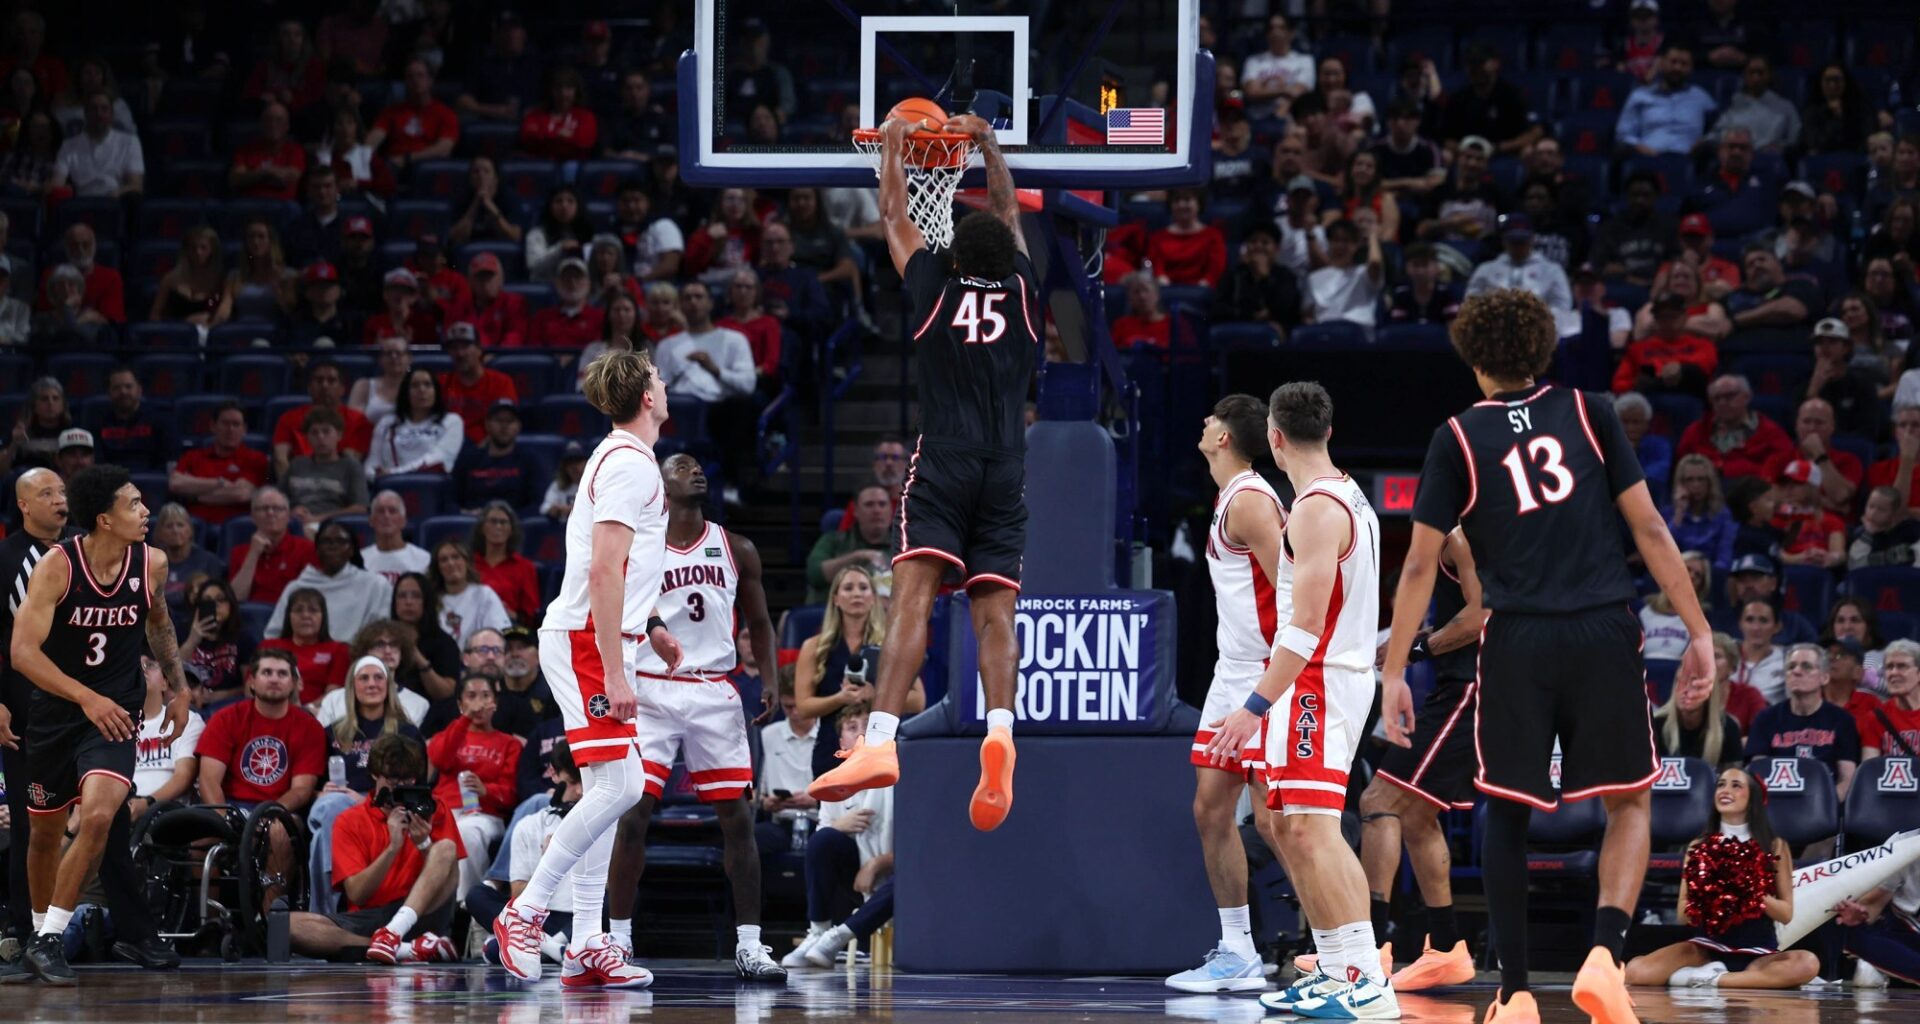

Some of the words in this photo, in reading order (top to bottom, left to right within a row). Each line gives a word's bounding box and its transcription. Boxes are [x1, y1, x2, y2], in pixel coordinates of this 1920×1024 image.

[951, 291, 1007, 344] 45
[1507, 406, 1532, 434] SY
[1500, 435, 1574, 514] 13
[68, 604, 139, 627] AZTECS
[687, 591, 706, 622] 3
[1080, 599, 1131, 610] FARMS
[85, 632, 107, 667] 3
[1015, 613, 1148, 670] OCKIN'
[1296, 693, 1319, 759] CATS
[1651, 757, 1691, 790] A
[1765, 758, 1805, 791] A
[1877, 758, 1918, 792] A
